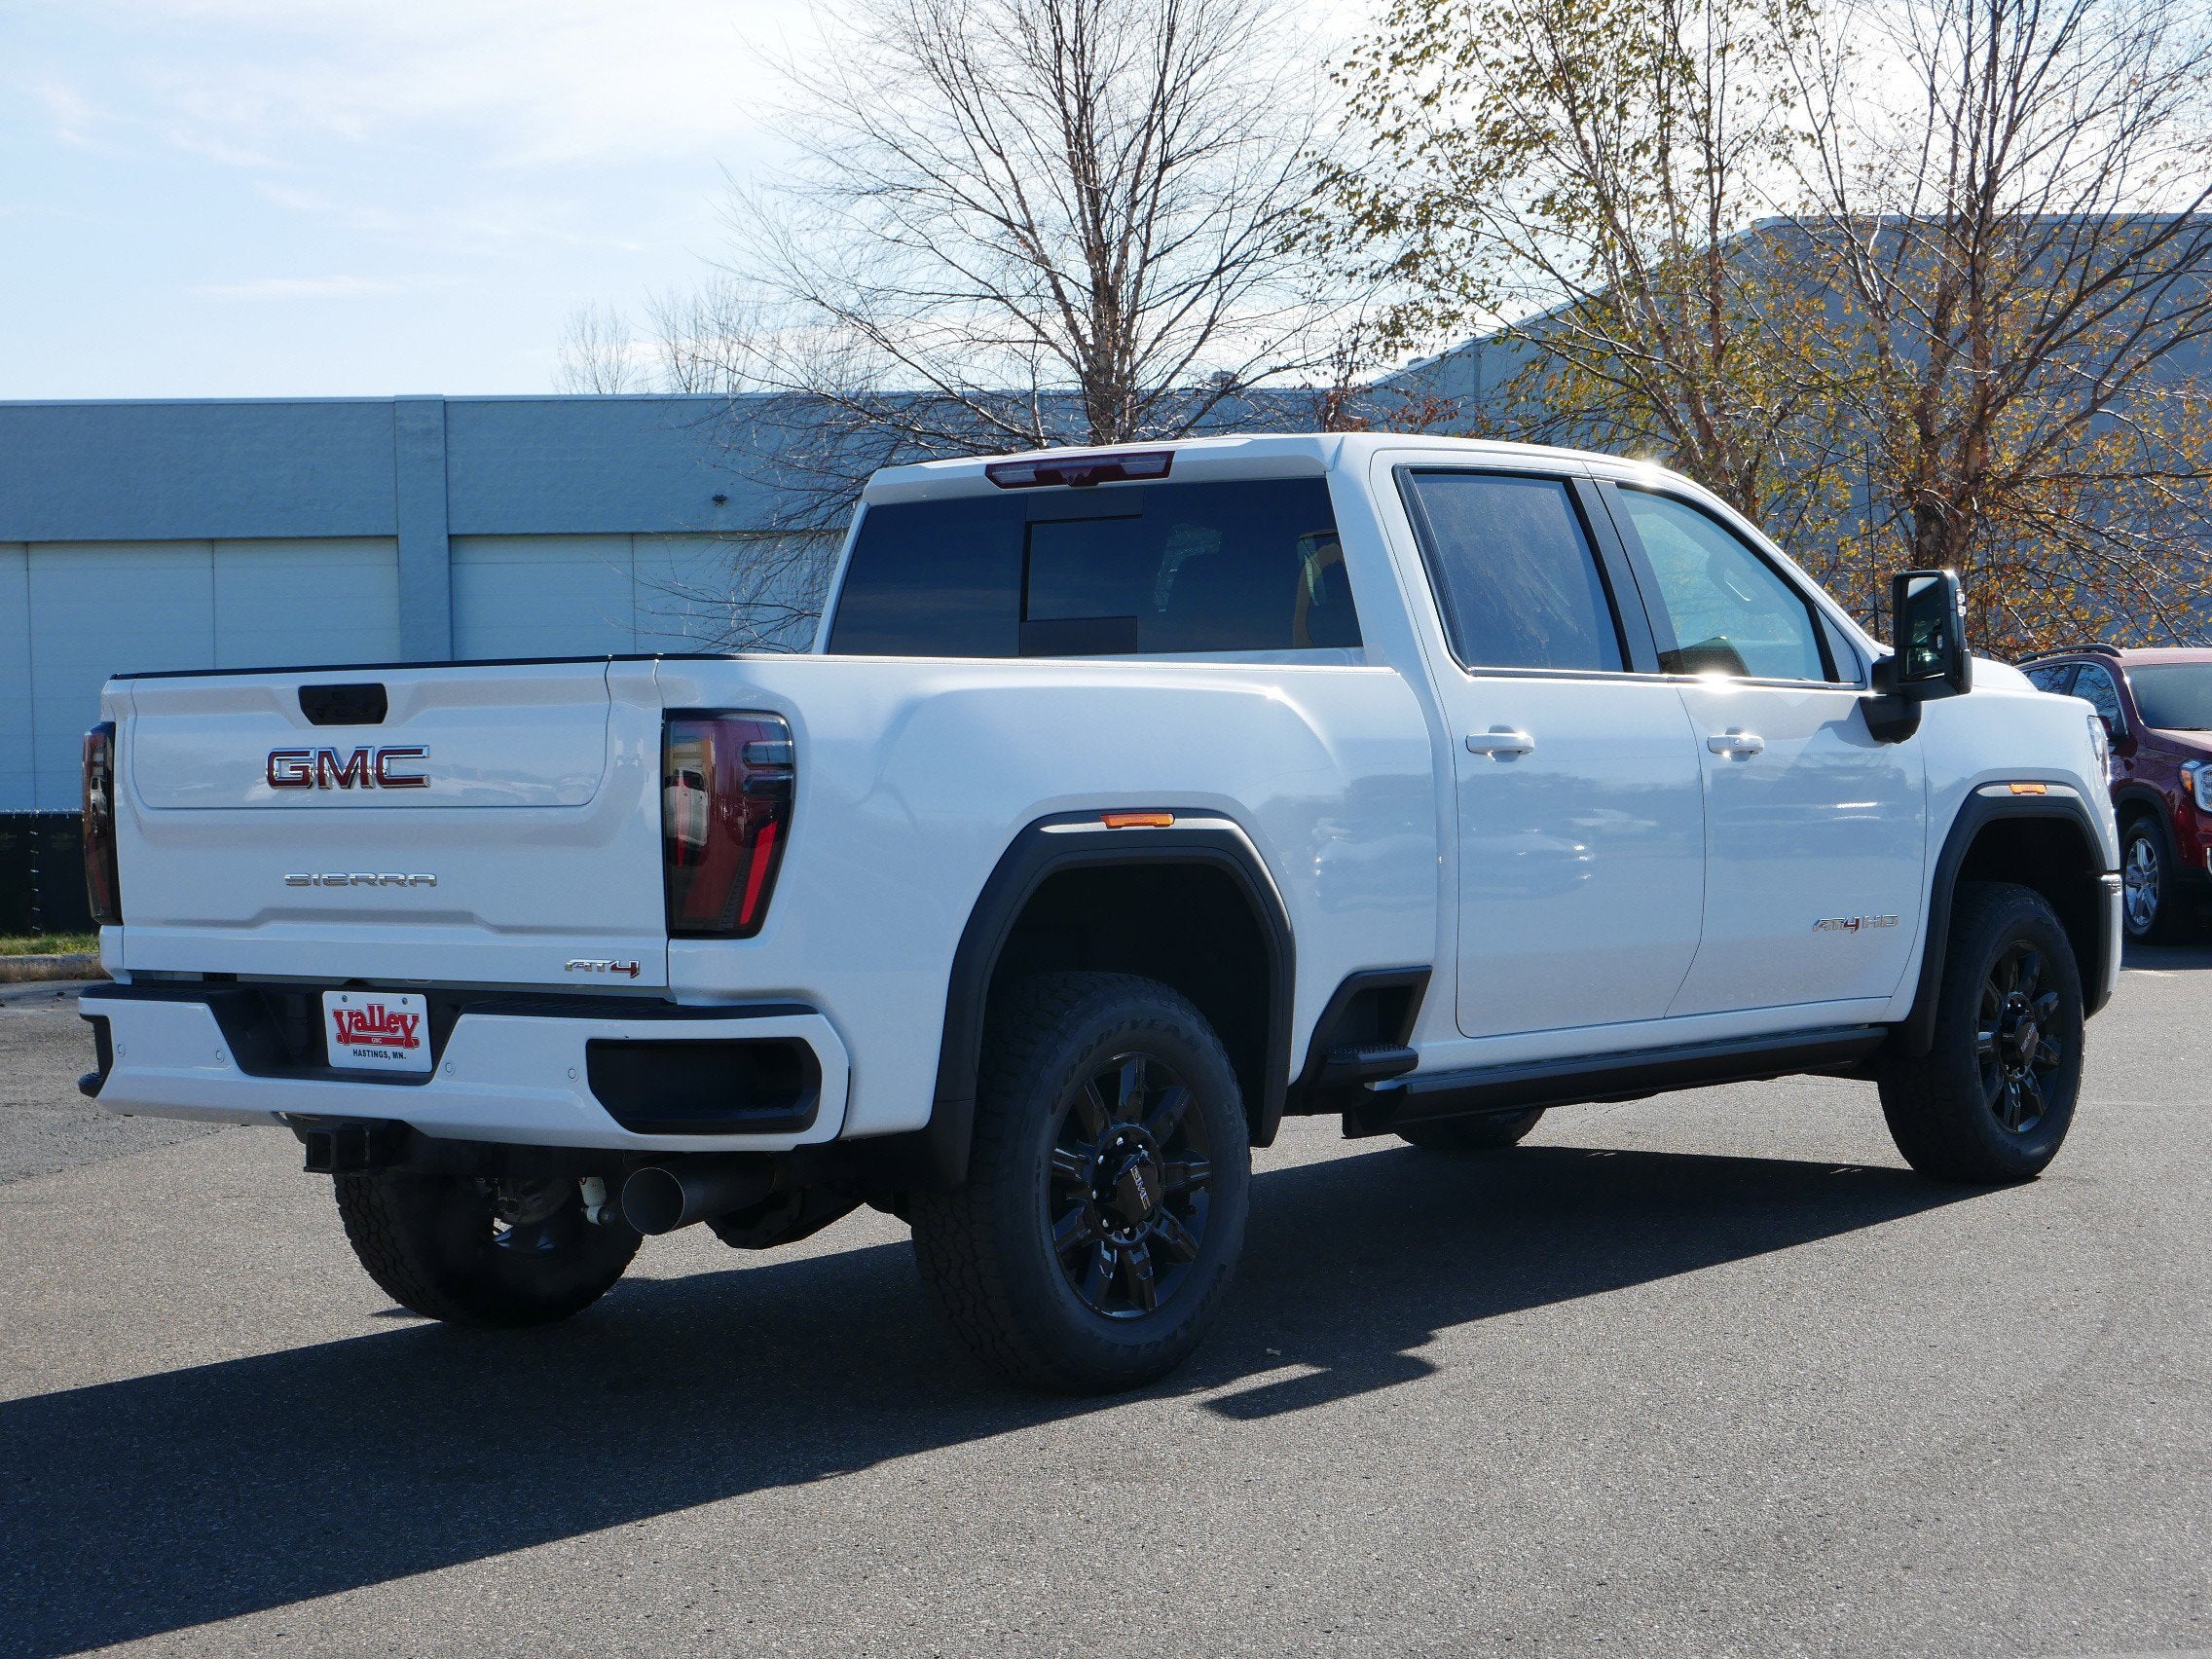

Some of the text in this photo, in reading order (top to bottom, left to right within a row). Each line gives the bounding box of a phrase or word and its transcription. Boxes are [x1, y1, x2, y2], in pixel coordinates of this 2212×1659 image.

[266, 745, 430, 790] GMC
[283, 871, 437, 888] SIERRA
[1813, 914, 1899, 934] AT4 HD
[565, 958, 640, 978] AT4
[352, 1049, 407, 1060] HASTINGS, MN.
